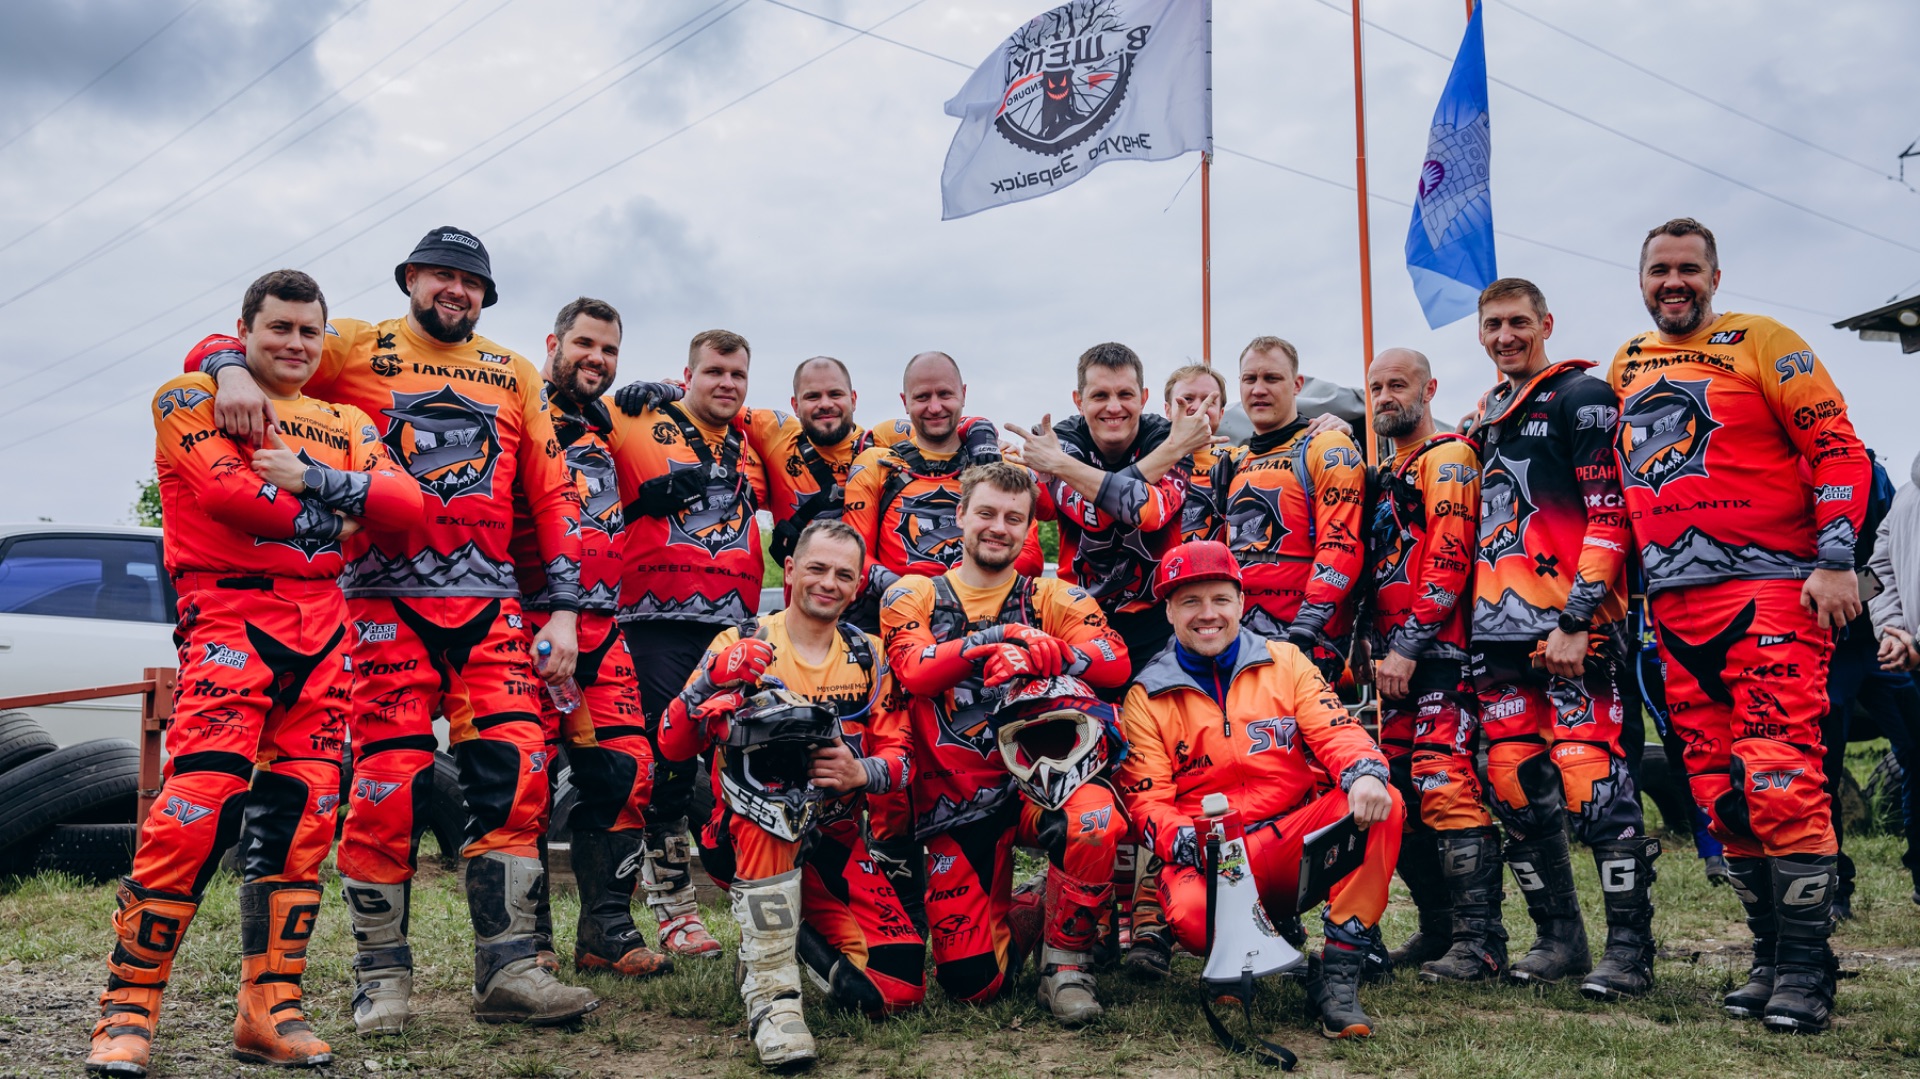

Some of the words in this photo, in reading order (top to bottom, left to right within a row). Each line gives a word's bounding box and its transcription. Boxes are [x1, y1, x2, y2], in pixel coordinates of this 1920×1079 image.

[412, 363, 518, 393] TAKAYAMA
[1815, 400, 1836, 412] ПРО
[1575, 464, 1617, 482] РЕСАН
[1652, 499, 1753, 516] EXLANTIX
[435, 516, 507, 530] EXLANTIX
[637, 563, 691, 573] EXEED
[368, 631, 396, 642] GLIDE
[218, 656, 245, 669] GLIDE
[1002, 643, 1029, 672] FOX
[1507, 861, 1545, 892] G
[1601, 858, 1636, 893] G
[1782, 873, 1830, 906] G
[347, 886, 392, 913] G
[747, 893, 794, 931] G
[137, 910, 180, 953] G
[280, 904, 319, 941] G
